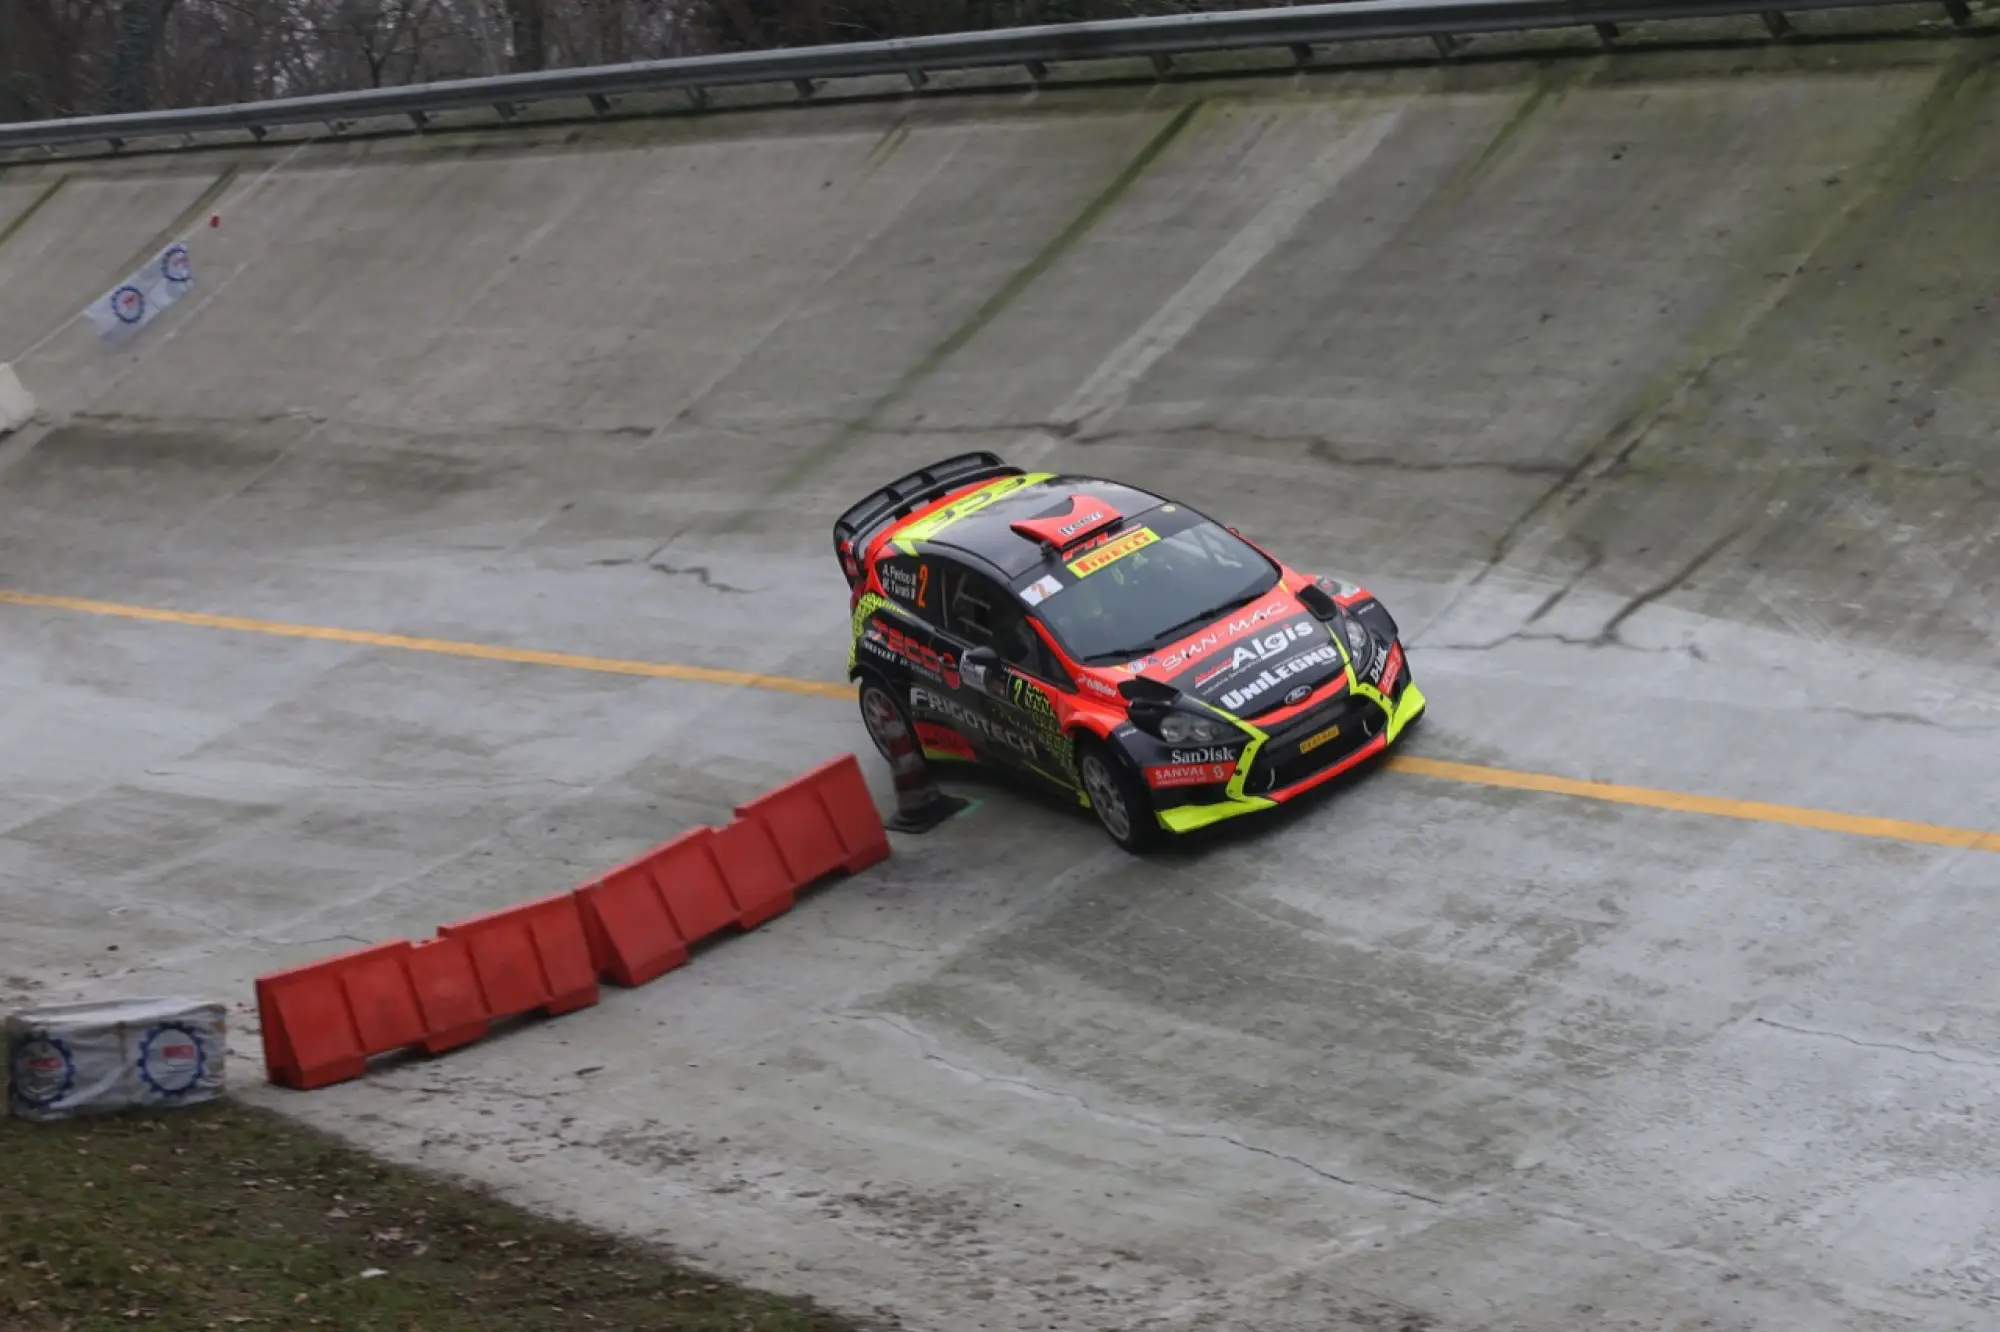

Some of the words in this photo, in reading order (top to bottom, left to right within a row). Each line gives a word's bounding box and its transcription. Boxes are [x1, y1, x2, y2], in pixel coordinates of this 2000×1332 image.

[917, 564, 928, 609] 2
[1232, 621, 1314, 669] Algis
[910, 687, 1038, 760] FRIGOTECH
[1171, 747, 1236, 765] SanDisk
